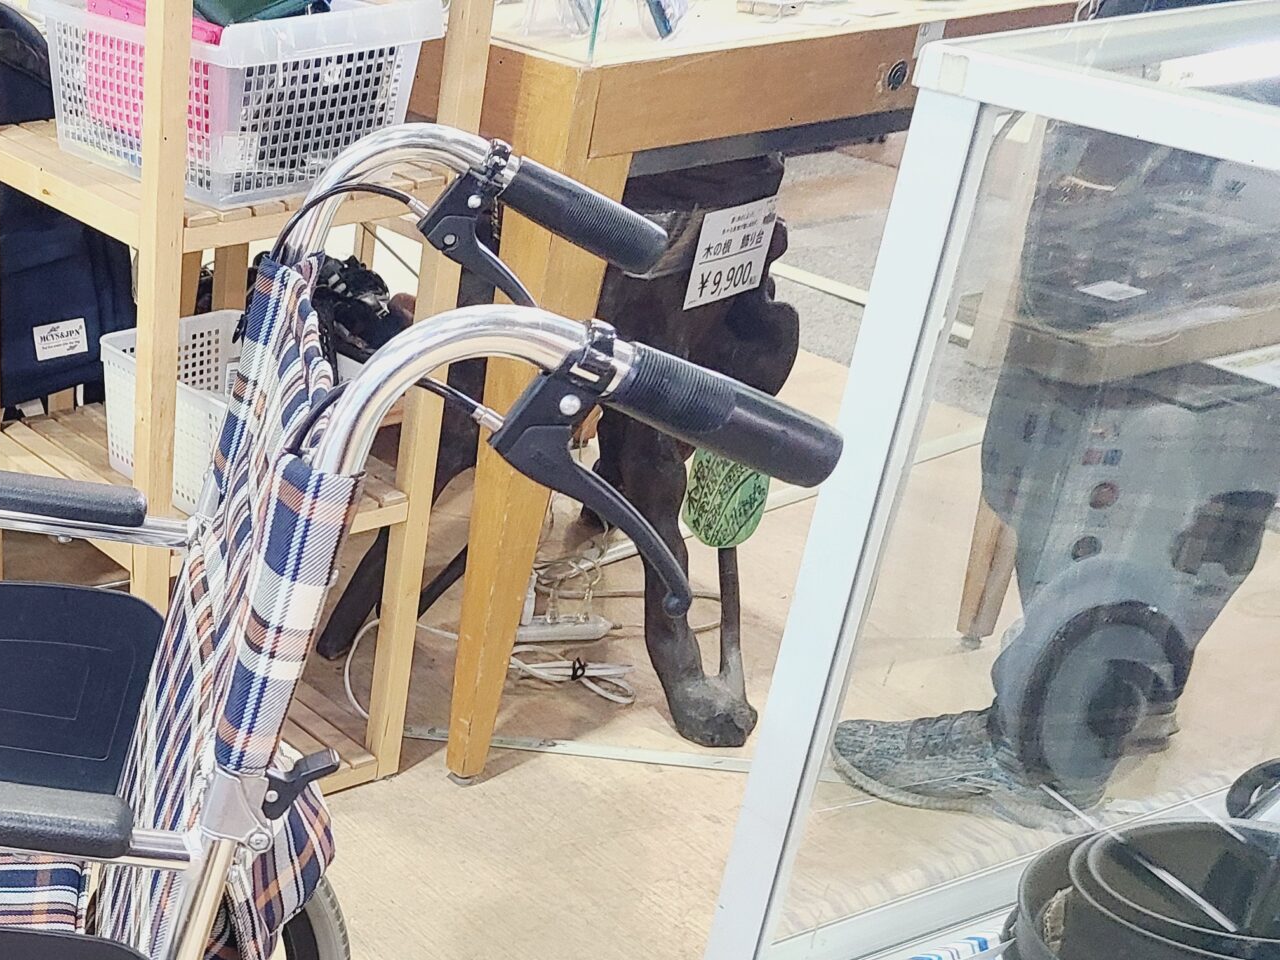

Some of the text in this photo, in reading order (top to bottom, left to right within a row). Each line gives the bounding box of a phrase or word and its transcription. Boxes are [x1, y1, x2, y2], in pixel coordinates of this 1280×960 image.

[702, 239, 733, 259] 木の根
[697, 260, 753, 298] ¥9,900
